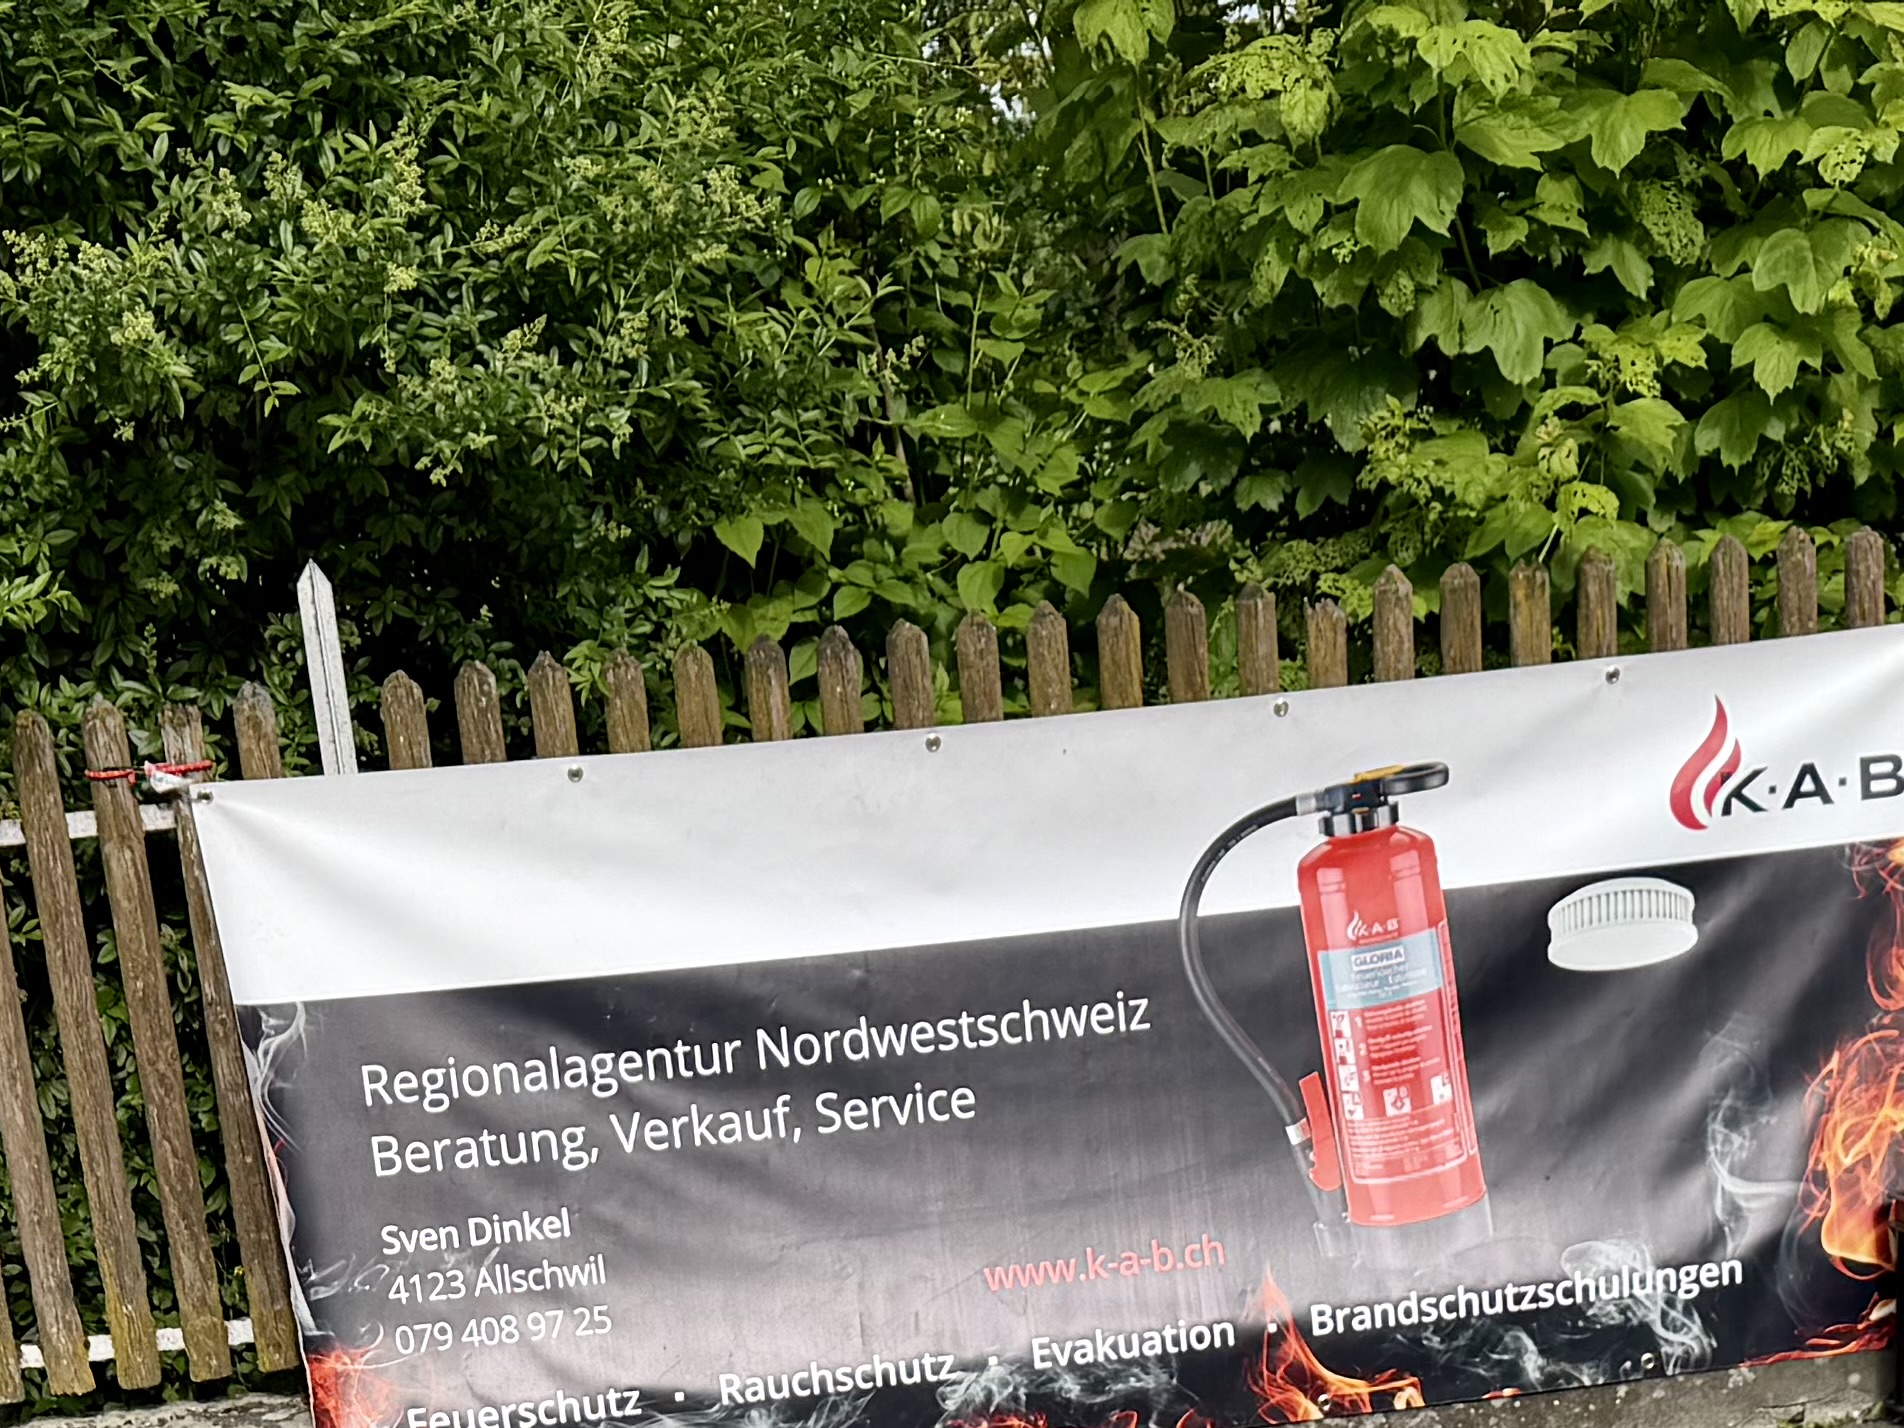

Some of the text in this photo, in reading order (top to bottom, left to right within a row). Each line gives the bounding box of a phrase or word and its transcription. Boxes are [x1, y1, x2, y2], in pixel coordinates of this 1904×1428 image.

[1353, 949, 1404, 967] GLORIA
[360, 990, 1152, 1113] Regionalagentur Nordwestschweiz
[370, 1082, 977, 1177] Beratung, Verkauf, Service
[380, 1206, 572, 1256] Sven Dinkel
[387, 1253, 607, 1305] 4123 Allschwil
[983, 1233, 1226, 1292] www.k-a-b.ch
[395, 1305, 613, 1355] 079 408 97 25
[718, 1352, 958, 1406] Rauchschutz
[1031, 1319, 1236, 1370] Evakuation
[1309, 1258, 1744, 1338] Brandschutzschulungen
